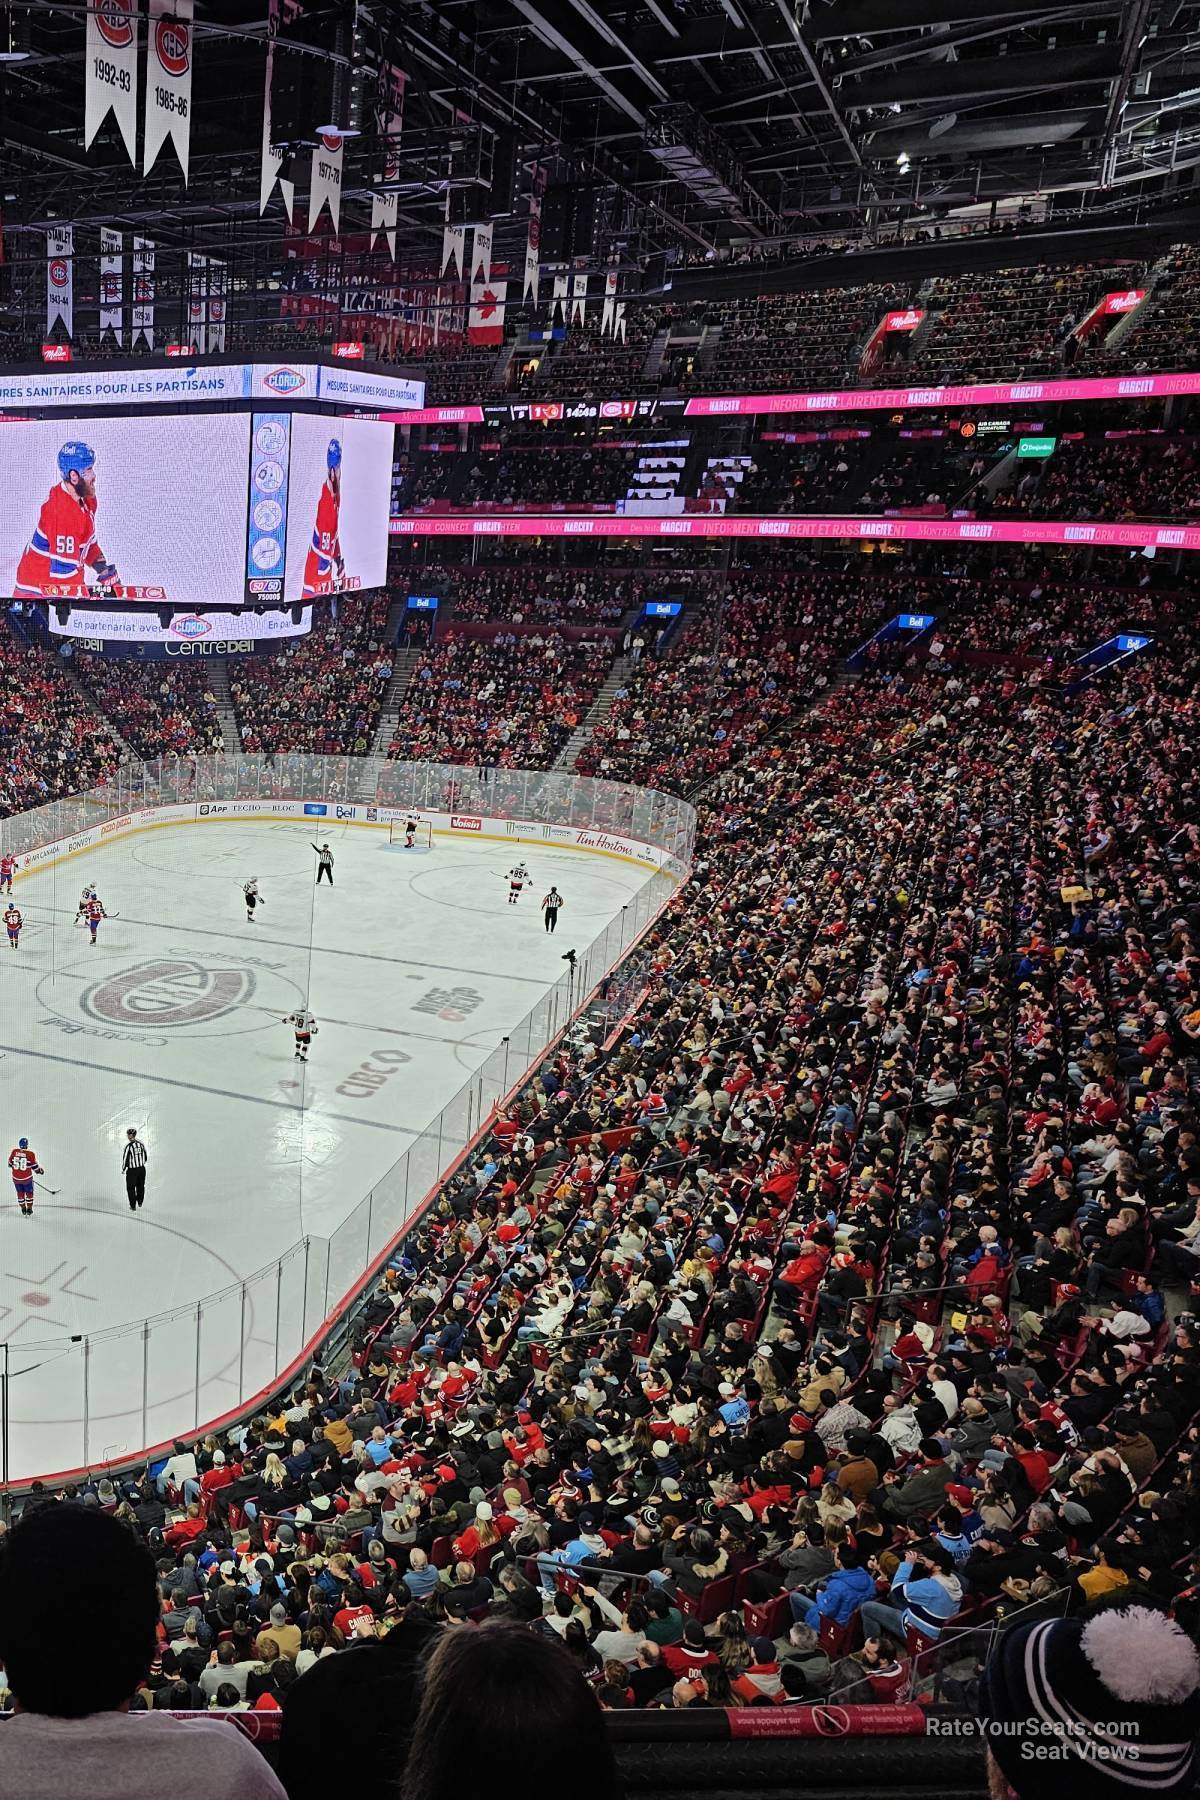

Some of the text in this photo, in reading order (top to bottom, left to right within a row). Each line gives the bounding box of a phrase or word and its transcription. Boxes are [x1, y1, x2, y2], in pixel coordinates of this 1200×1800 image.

[93, 57, 131, 92] 1992-93
[155, 86, 188, 118] 1985-86
[318, 160, 340, 184] 1977-78
[1109, 297, 1141, 310] Molson
[890, 316, 919, 328] Molson
[269, 374, 302, 388] CLOROX
[1119, 380, 1154, 394] NARCITY
[26, 385, 92, 397] SANITAIRES
[95, 383, 127, 394] POUR
[131, 382, 152, 393] LES
[156, 379, 225, 391] PARTISANS
[350, 384, 374, 396] SANITAIRES
[1010, 386, 1042, 399] NARCITY
[709, 400, 740, 411] NARCITY
[807, 391, 941, 409] NARCITY NARCITY
[566, 407, 596, 418] 14:48
[564, 521, 691, 533] NARCITY NARCITY
[759, 522, 790, 534] NARCITY
[861, 523, 892, 535] NARCITY
[960, 525, 992, 537] NARCITY
[1064, 527, 1095, 541] NARCITY
[1156, 530, 1185, 543] NARCITY
[56, 536, 75, 553] 58
[416, 598, 430, 608] Bell
[656, 603, 672, 614] Bell
[73, 619, 83, 629] En
[85, 620, 135, 633] partenariat
[908, 616, 924, 627] Bell
[336, 806, 355, 819] Bell
[452, 818, 480, 831] Voisin
[69, 837, 92, 853] BONVOY
[576, 831, 633, 856] Tim Hortons
[514, 870, 523, 879] 85
[336, 1062, 399, 1099] CIBC
[757, 1717, 787, 1725] appuyer
